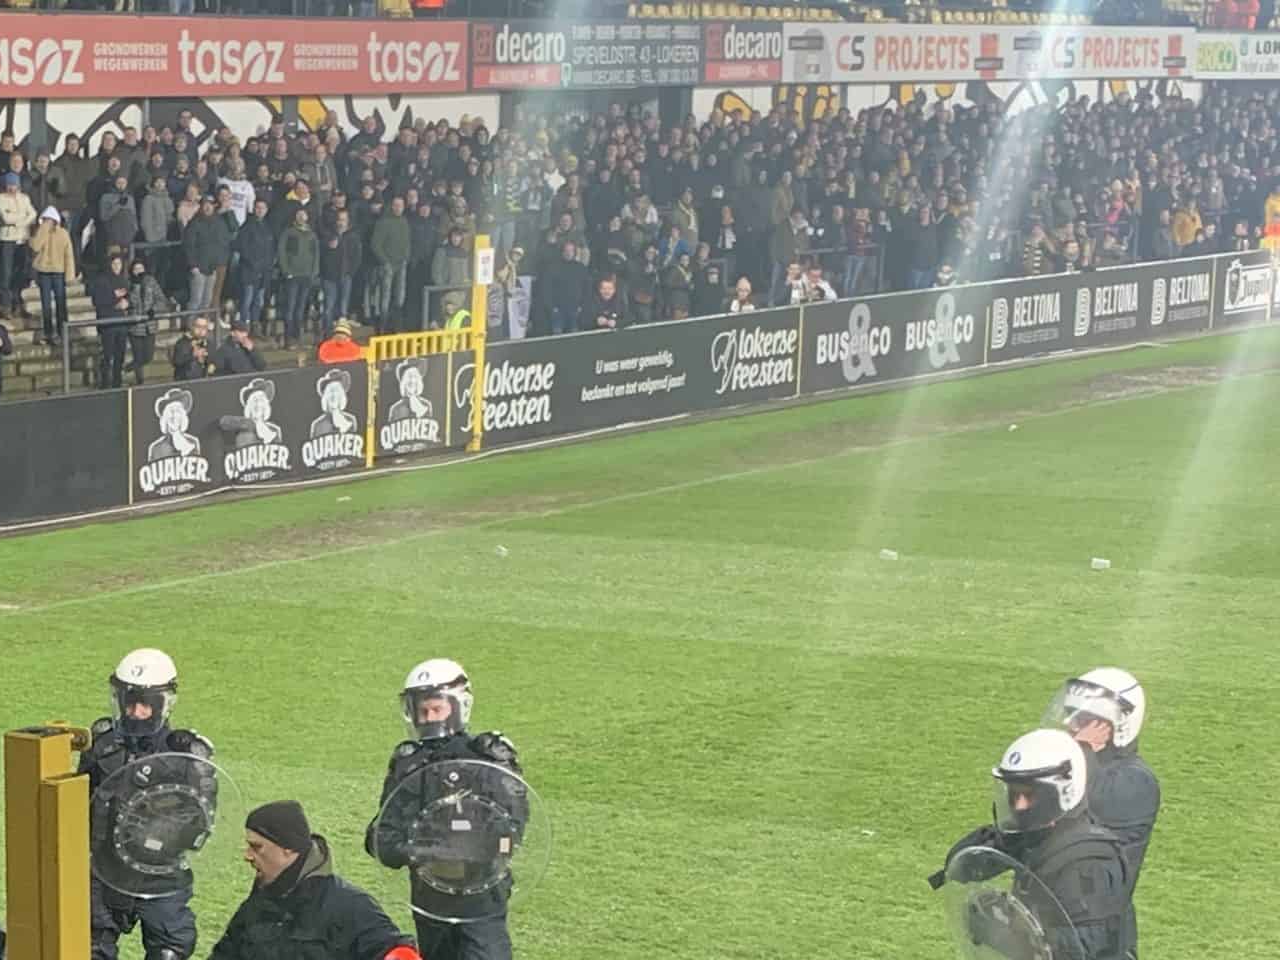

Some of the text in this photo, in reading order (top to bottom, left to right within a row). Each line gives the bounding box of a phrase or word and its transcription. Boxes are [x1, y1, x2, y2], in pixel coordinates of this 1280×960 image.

[495, 24, 565, 63] decaro
[724, 23, 781, 60] decaro
[835, 35, 970, 71] CS PROJECTS
[1050, 35, 1160, 69] CS PROJECTS
[1094, 282, 1139, 317] BELTONA
[1170, 273, 1210, 307] BELTONA
[1012, 292, 1061, 329] BELTONA
[738, 326, 798, 362] lokerse
[731, 357, 794, 392] feesten
[481, 394, 552, 432] eesten
[302, 433, 363, 468] QUAKER
[380, 416, 440, 450] QUAKER
[139, 455, 210, 494] QUAKER
[224, 444, 290, 481] QUAKER
